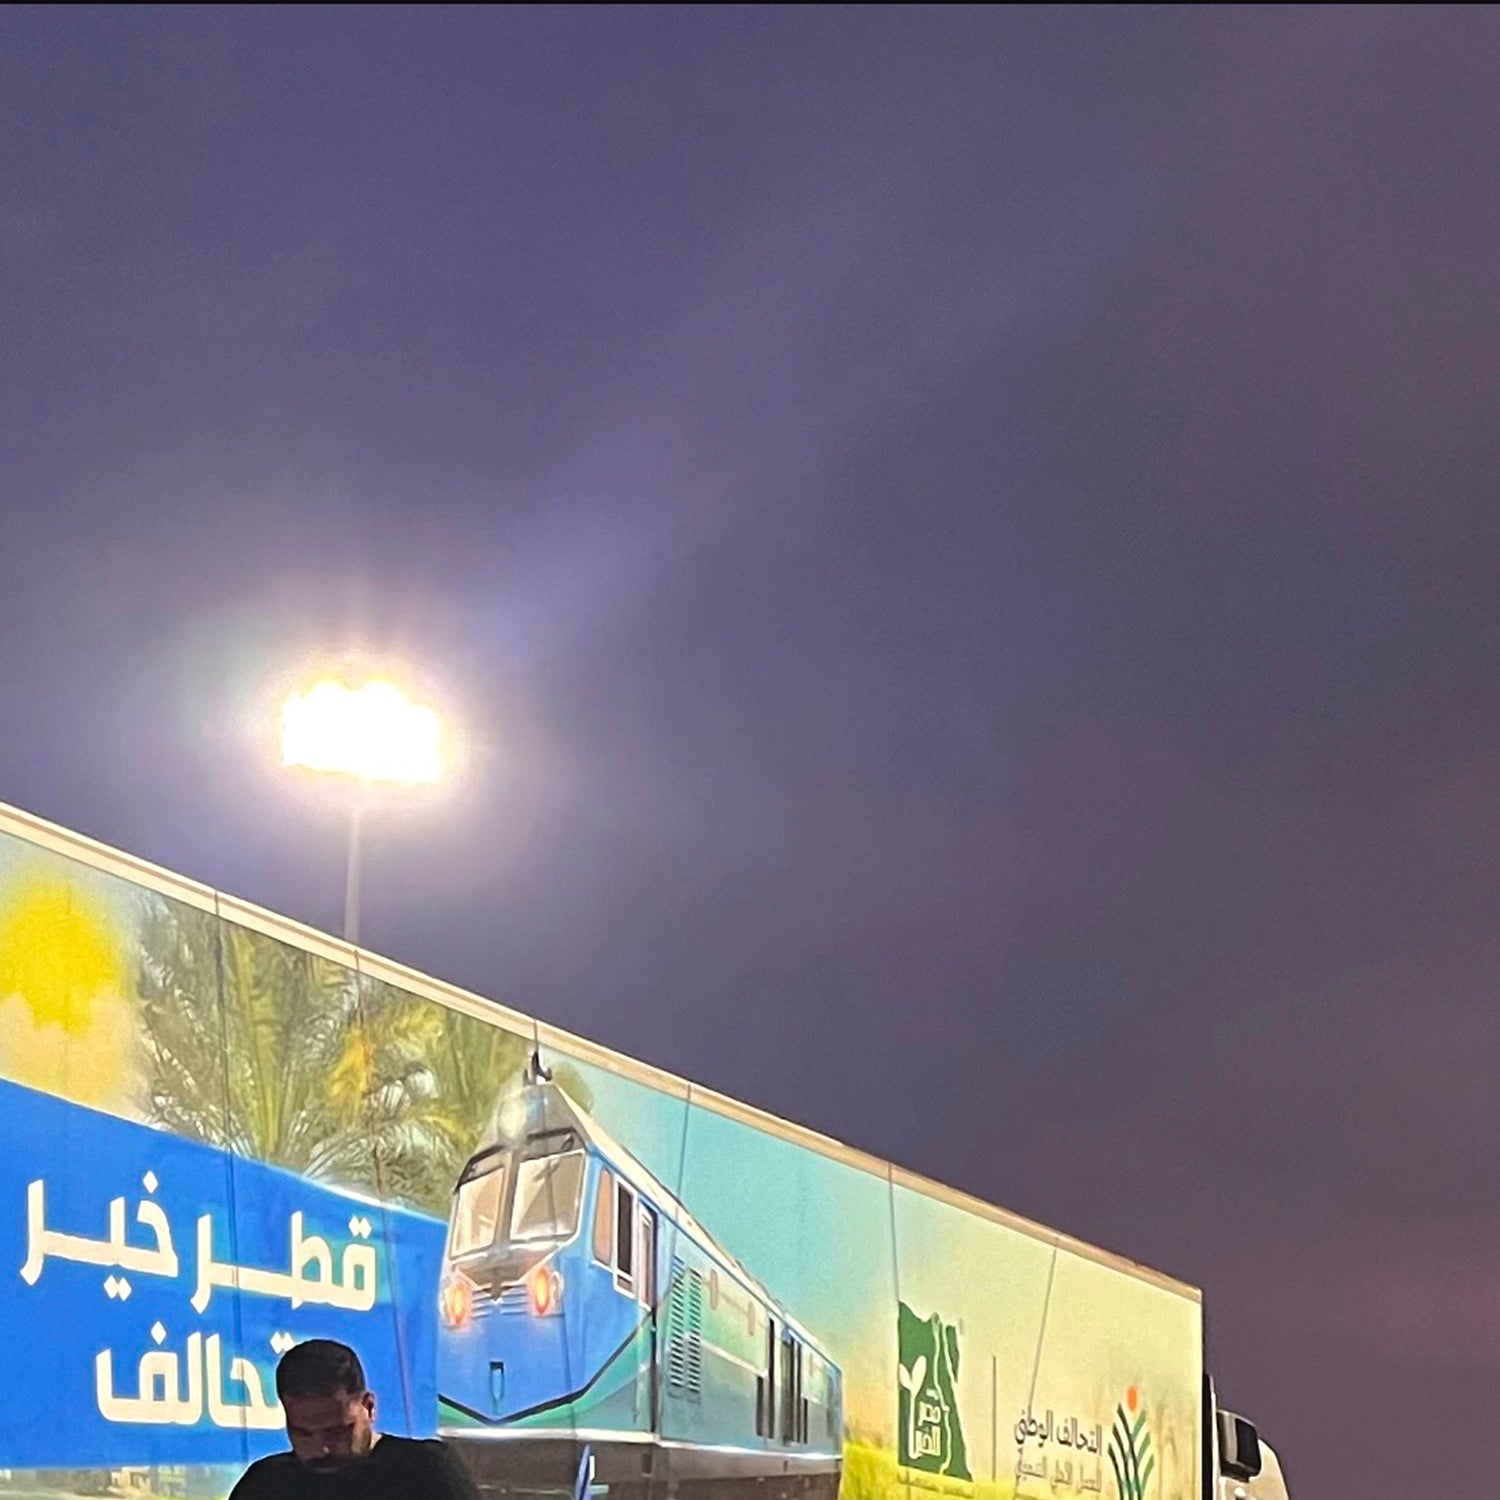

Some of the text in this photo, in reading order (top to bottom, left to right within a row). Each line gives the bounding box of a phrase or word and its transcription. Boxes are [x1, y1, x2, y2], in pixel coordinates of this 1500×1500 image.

[20, 1171, 376, 1314] قطر خير
[1056, 1416, 1102, 1456] التحالف
